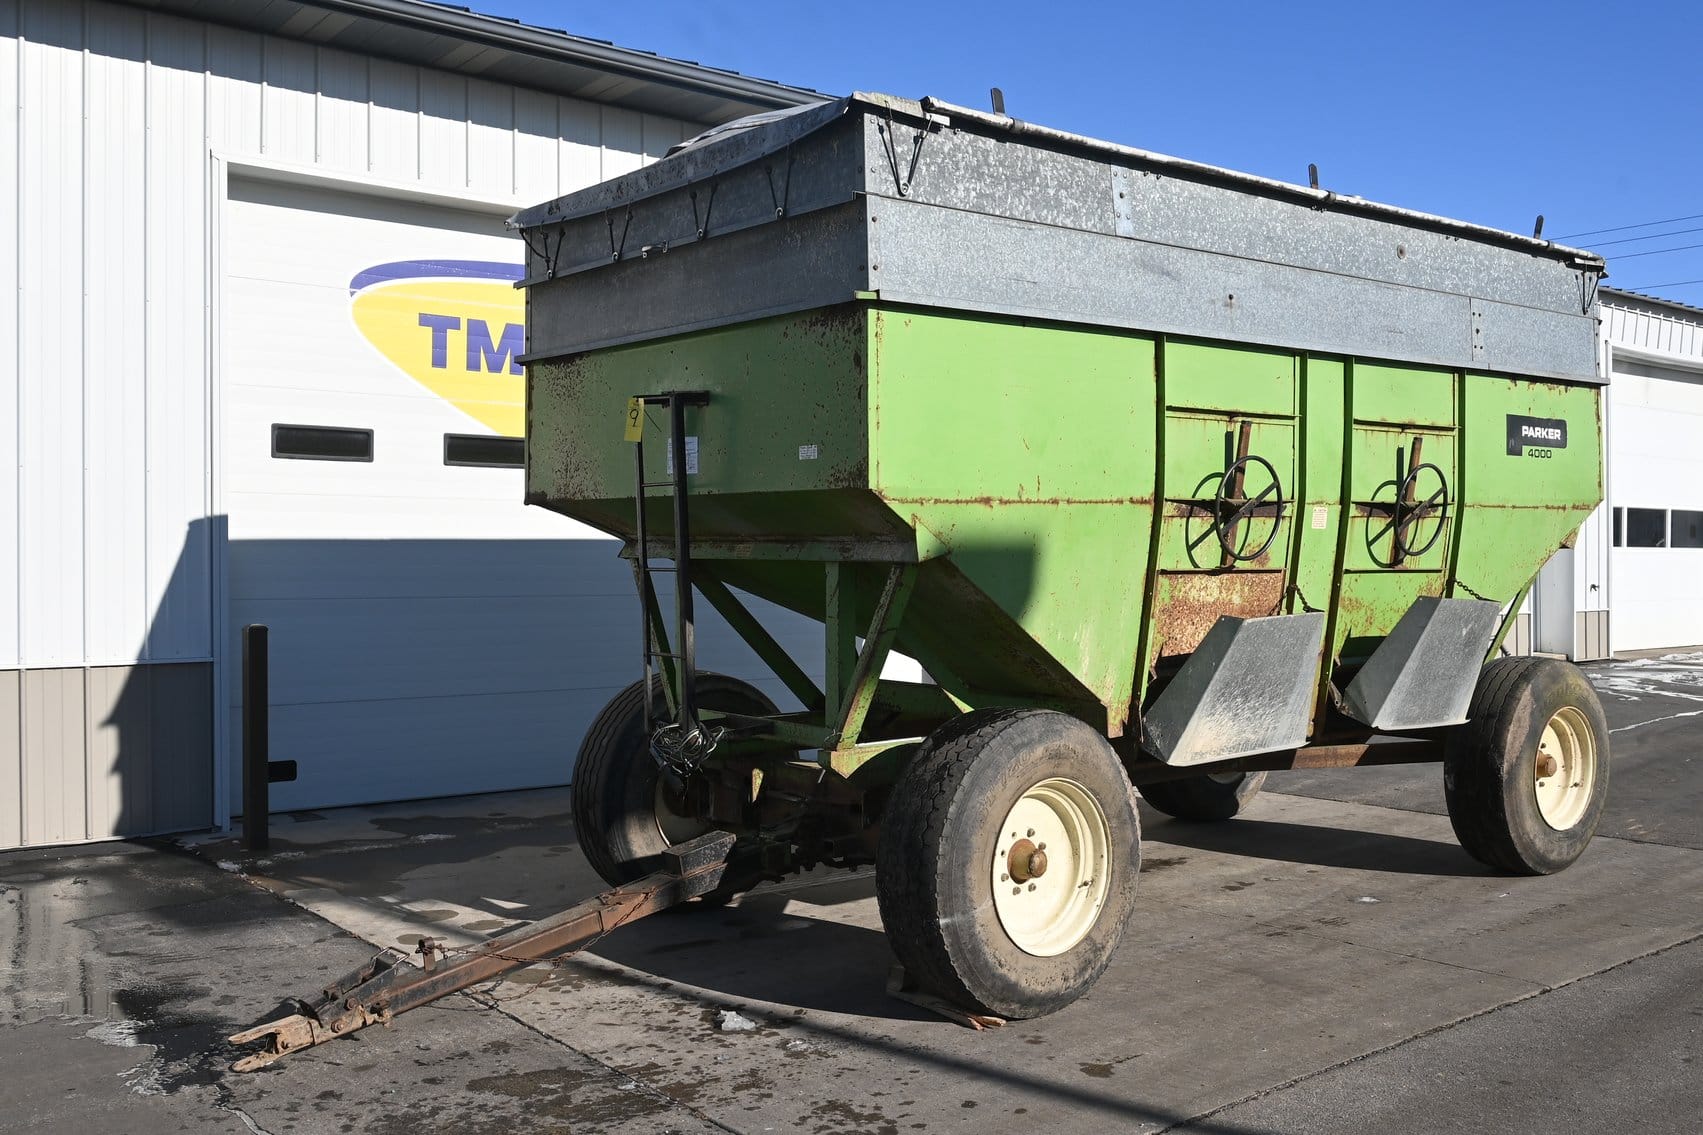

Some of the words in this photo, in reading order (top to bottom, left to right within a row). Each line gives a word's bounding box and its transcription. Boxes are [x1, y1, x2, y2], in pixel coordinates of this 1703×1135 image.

[629, 408, 639, 427] 9
[1521, 425, 1562, 441] PARKER
[1528, 448, 1553, 459] 4000
